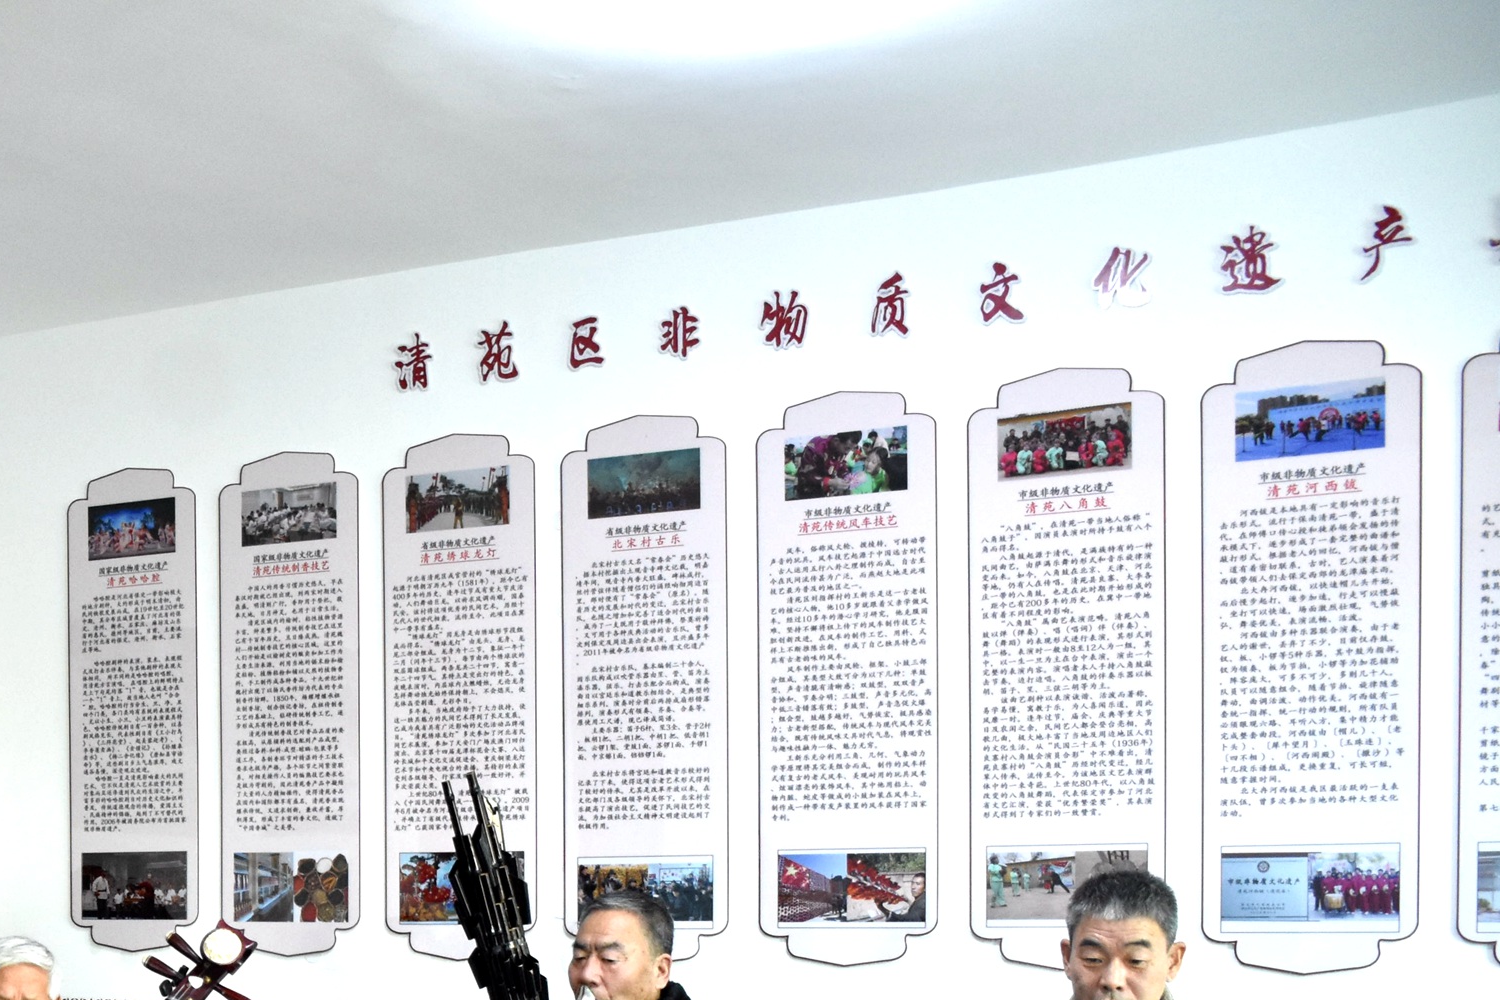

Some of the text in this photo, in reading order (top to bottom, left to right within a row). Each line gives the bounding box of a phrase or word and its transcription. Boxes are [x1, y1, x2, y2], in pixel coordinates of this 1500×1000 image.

[1260, 462, 1365, 482] 市级非物质文化遗产
[1018, 481, 1113, 500] 市级非物质文化遗产
[1268, 478, 1358, 498] 清苑河西钹
[804, 501, 891, 519] 市级非物质文化遗产
[1026, 496, 1107, 515] 清苑八角鼓
[605, 520, 686, 536] 省级非物质文化遗产
[799, 514, 897, 534] 清苑传统风车技艺
[421, 535, 495, 551] 省级非物质文化遗产
[612, 534, 680, 550] 北宋村古乐
[982, 543, 1019, 553] 角而得名。
[253, 549, 328, 563] 国家级非物质文化遗产
[420, 547, 496, 563] 清苑绣球龙灯
[98, 561, 168, 575] 国家级非物质文化遗产
[253, 560, 329, 576] 清苑传统制香技艺
[107, 573, 160, 587] 清苑哈哈腔
[982, 606, 1073, 620] 区有着不同程度的影响。
[772, 813, 790, 821] 专利。
[1220, 809, 1242, 818] 活动。
